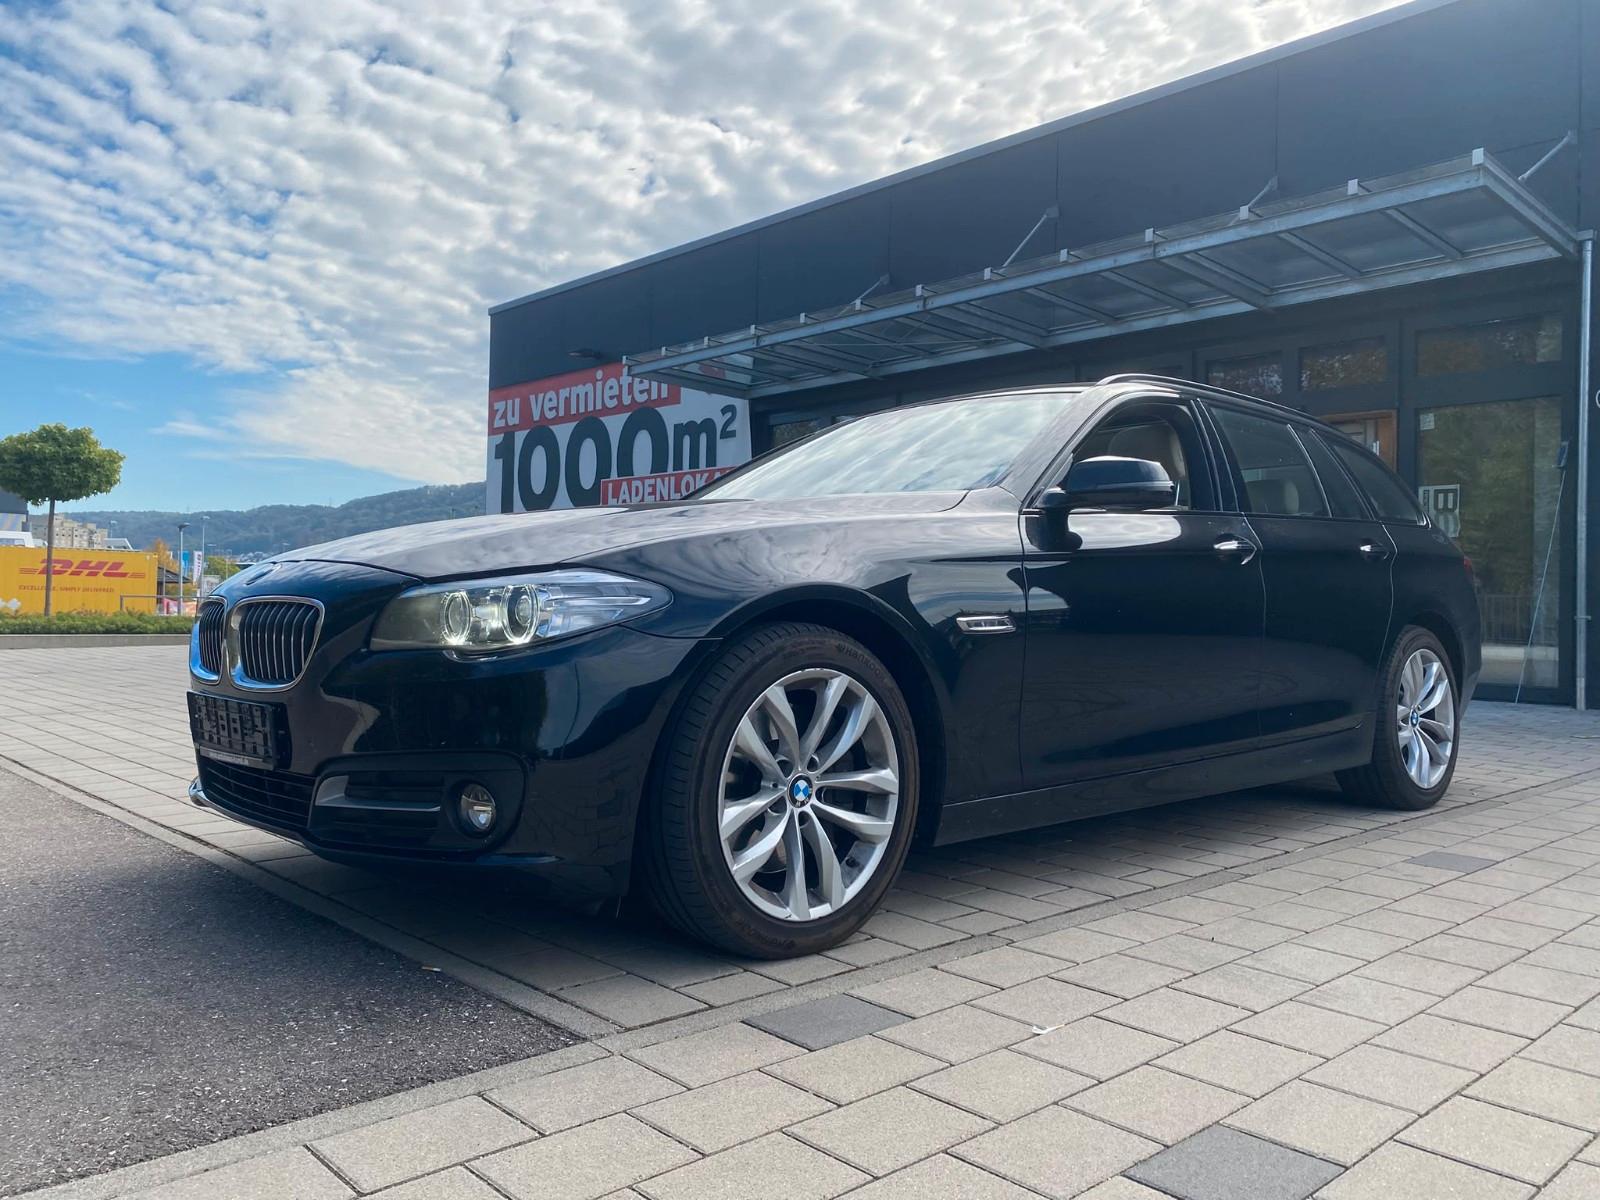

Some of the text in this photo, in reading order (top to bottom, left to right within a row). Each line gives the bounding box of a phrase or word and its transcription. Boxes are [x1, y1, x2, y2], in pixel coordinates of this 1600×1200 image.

[493, 366, 669, 428] zu vermieten
[38, 558, 129, 578] DHL
